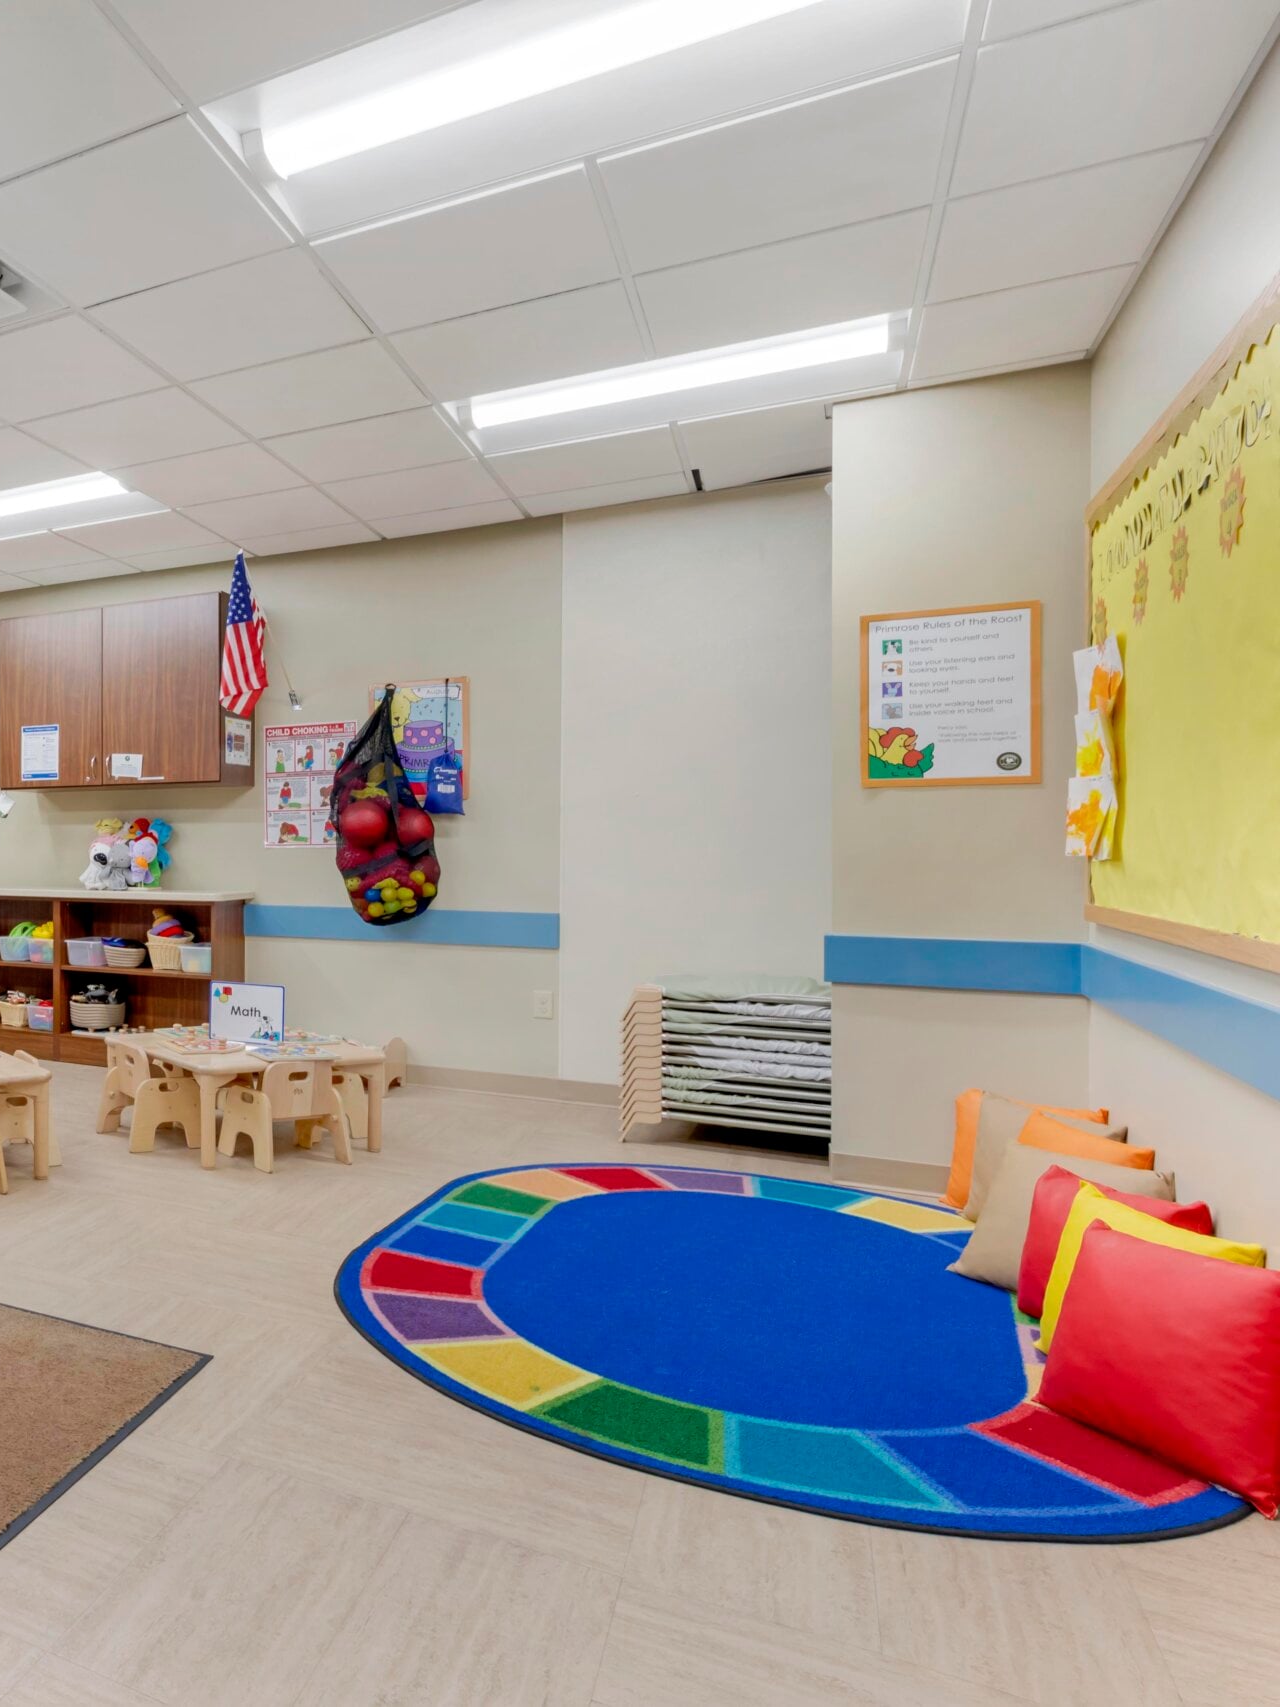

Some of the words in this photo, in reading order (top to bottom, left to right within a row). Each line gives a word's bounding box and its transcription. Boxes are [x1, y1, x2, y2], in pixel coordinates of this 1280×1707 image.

[875, 624, 919, 633] Primrose
[923, 621, 950, 629] Rules
[954, 619, 965, 627] of
[969, 618, 987, 626] the
[991, 614, 1022, 624] Roost
[920, 637, 937, 645] kind
[949, 634, 980, 643] yourself
[982, 632, 1000, 640] and
[925, 659, 941, 667] your
[943, 656, 977, 664] listening
[931, 680, 949, 688] your
[944, 699, 975, 708] walking
[266, 728, 290, 737] CHILD
[292, 725, 329, 735] CHOKING
[230, 1005, 261, 1017] Math
